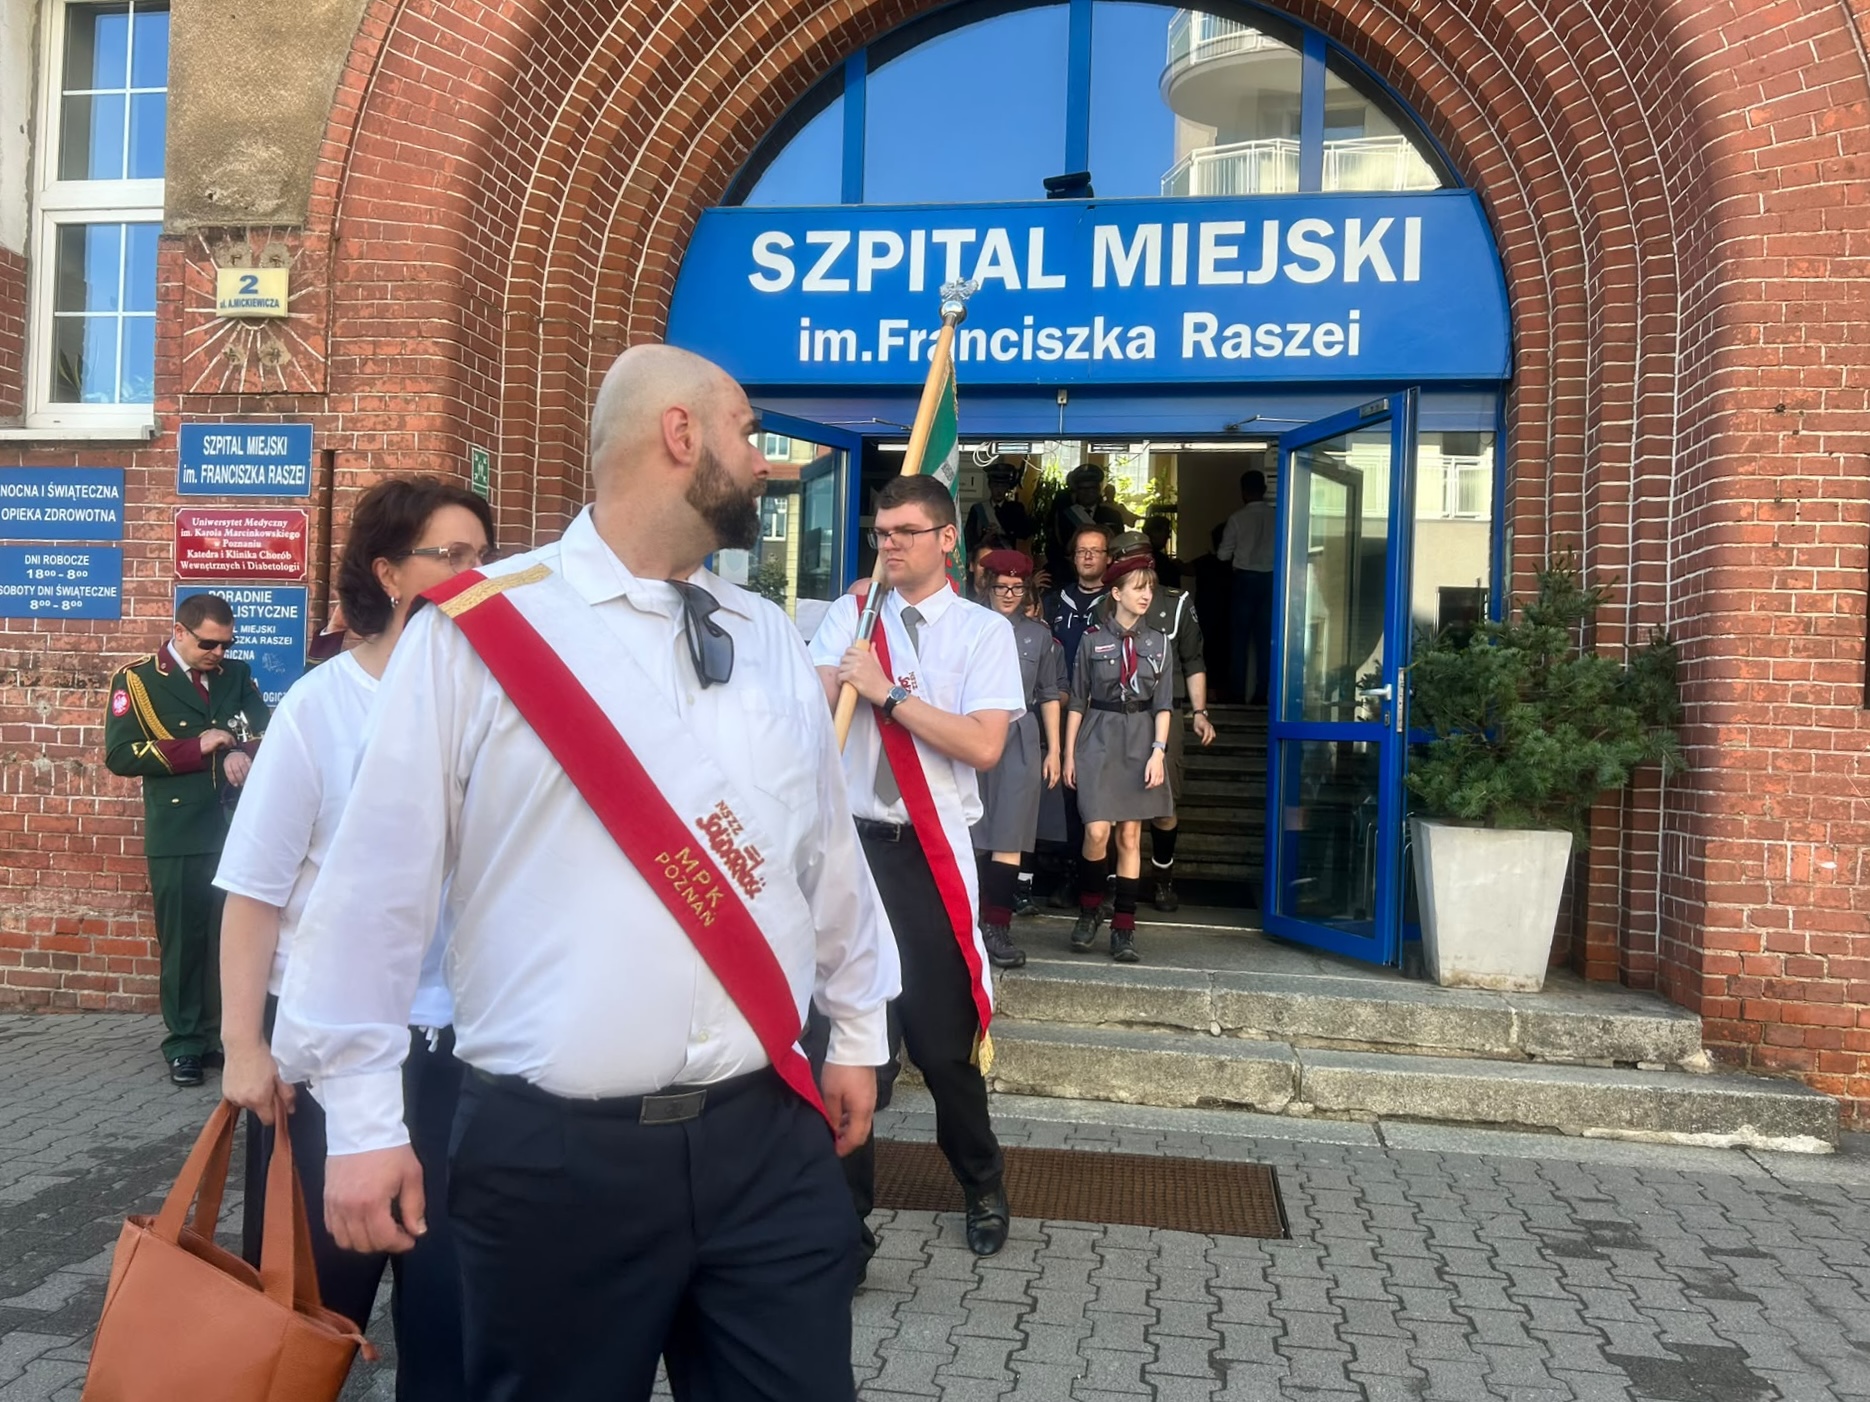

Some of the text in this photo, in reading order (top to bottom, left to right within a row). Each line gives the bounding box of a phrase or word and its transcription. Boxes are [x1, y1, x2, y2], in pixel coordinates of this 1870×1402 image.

[748, 216, 1422, 292] SZPITAL MIEJSKI
[239, 275, 259, 294] 2
[1181, 309, 1361, 359] Raszei
[203, 435, 288, 456] SZPITAL MIEJSKI
[183, 464, 306, 485] im. FRANCISZKA RASZEI
[0, 481, 119, 501] NOCNA I ŚWIĄTECZNA
[1, 507, 117, 522] OPIEKA ZDROWOTNA
[192, 517, 288, 529] Uniwersytet Medyczny
[180, 529, 301, 541] im. Karola Marcinkowskiego
[222, 539, 262, 548] Poznaniu
[24, 555, 90, 566] DNI ROBOCZE
[187, 549, 219, 559] Katedra
[225, 550, 257, 559] Klinika
[259, 550, 292, 560] Chorób
[180, 561, 241, 571] Wewnętrznych
[247, 562, 300, 572] Diabetologii
[37, 586, 54, 596] DNI
[55, 583, 117, 599] ŚWIĄTECZNE
[240, 625, 276, 634] MIEJSKI
[260, 636, 293, 645] RASZEI
[715, 799, 744, 836] NSZZ
[654, 851, 716, 928] POZNAŃ
